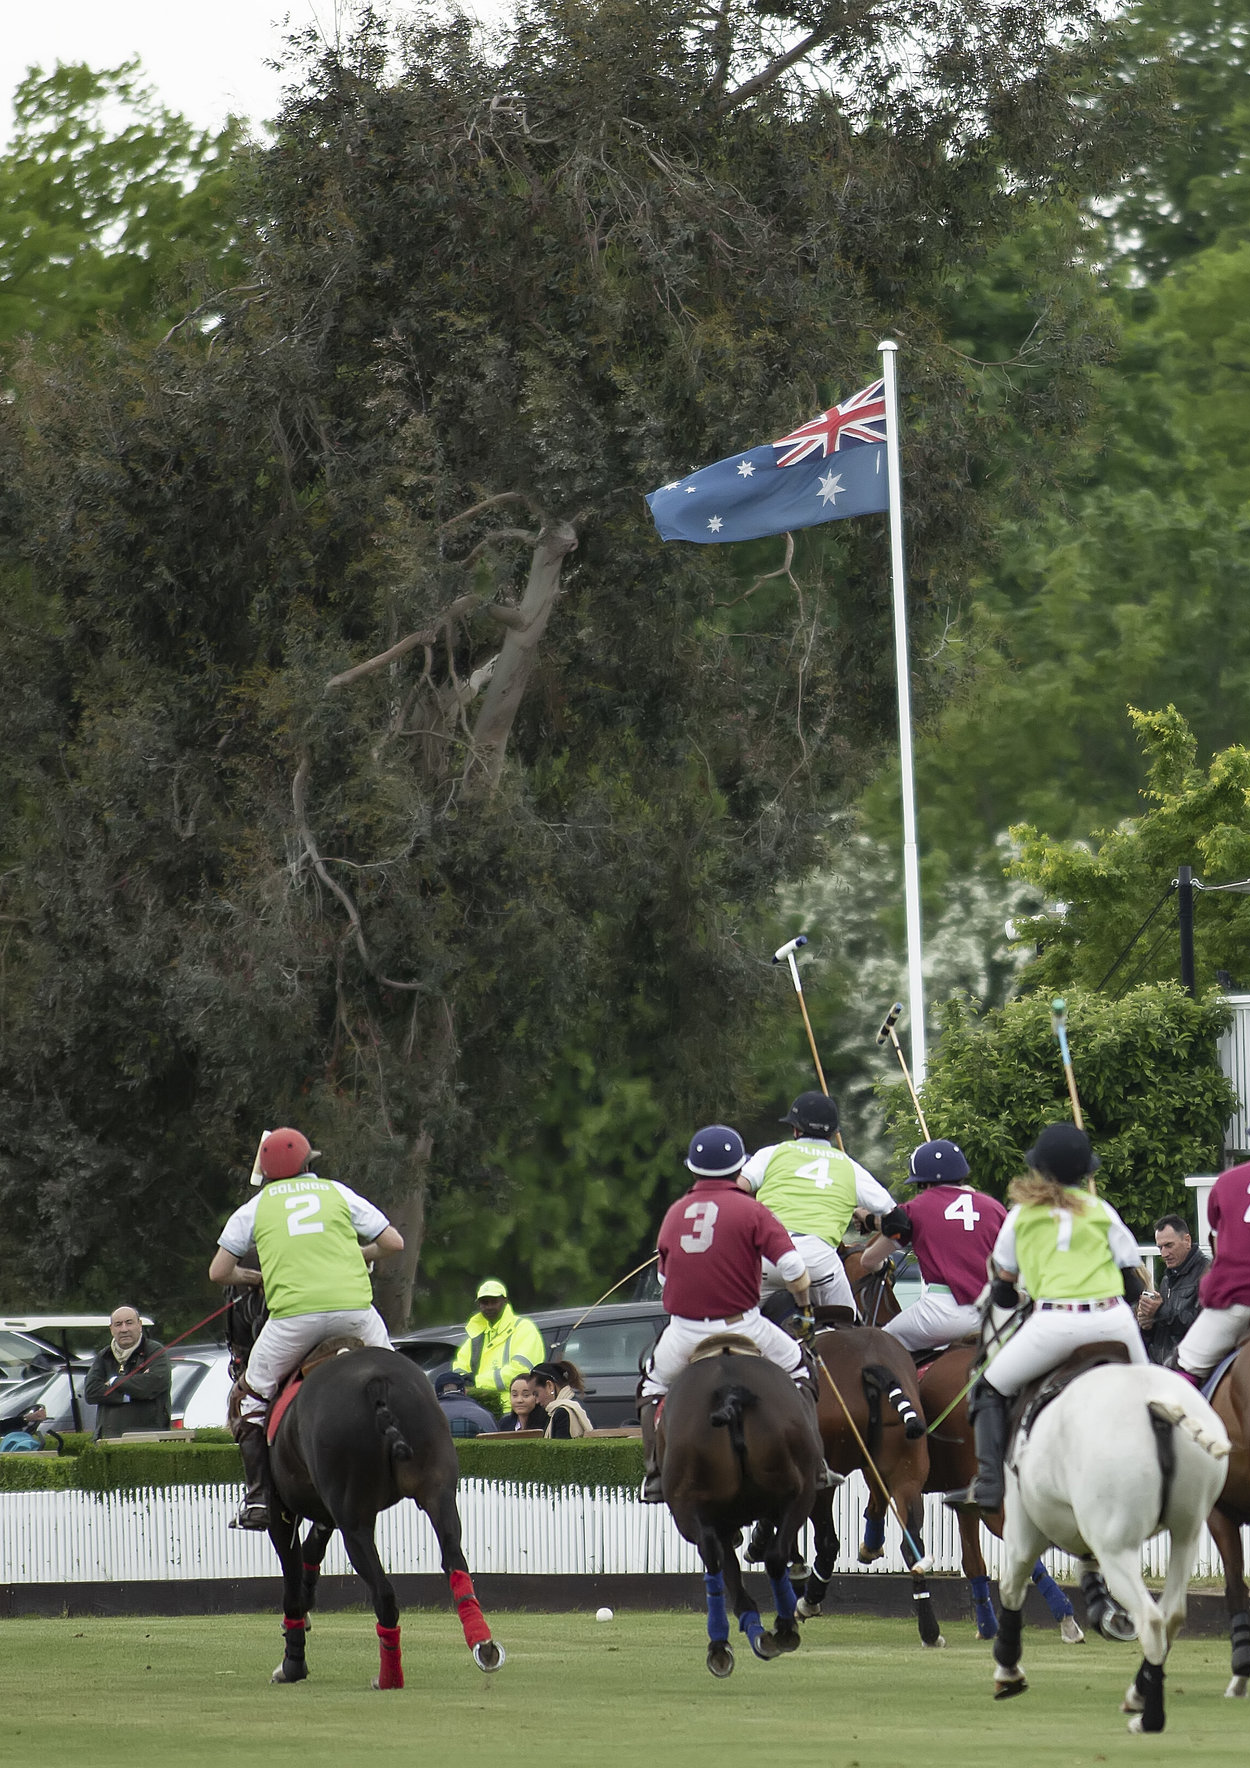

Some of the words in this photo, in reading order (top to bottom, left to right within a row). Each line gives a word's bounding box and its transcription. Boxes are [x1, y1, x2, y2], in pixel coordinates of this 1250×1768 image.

[794, 1157, 833, 1189] 4
[285, 1193, 324, 1236] 2
[680, 1200, 719, 1254] 3
[944, 1193, 980, 1231] 4
